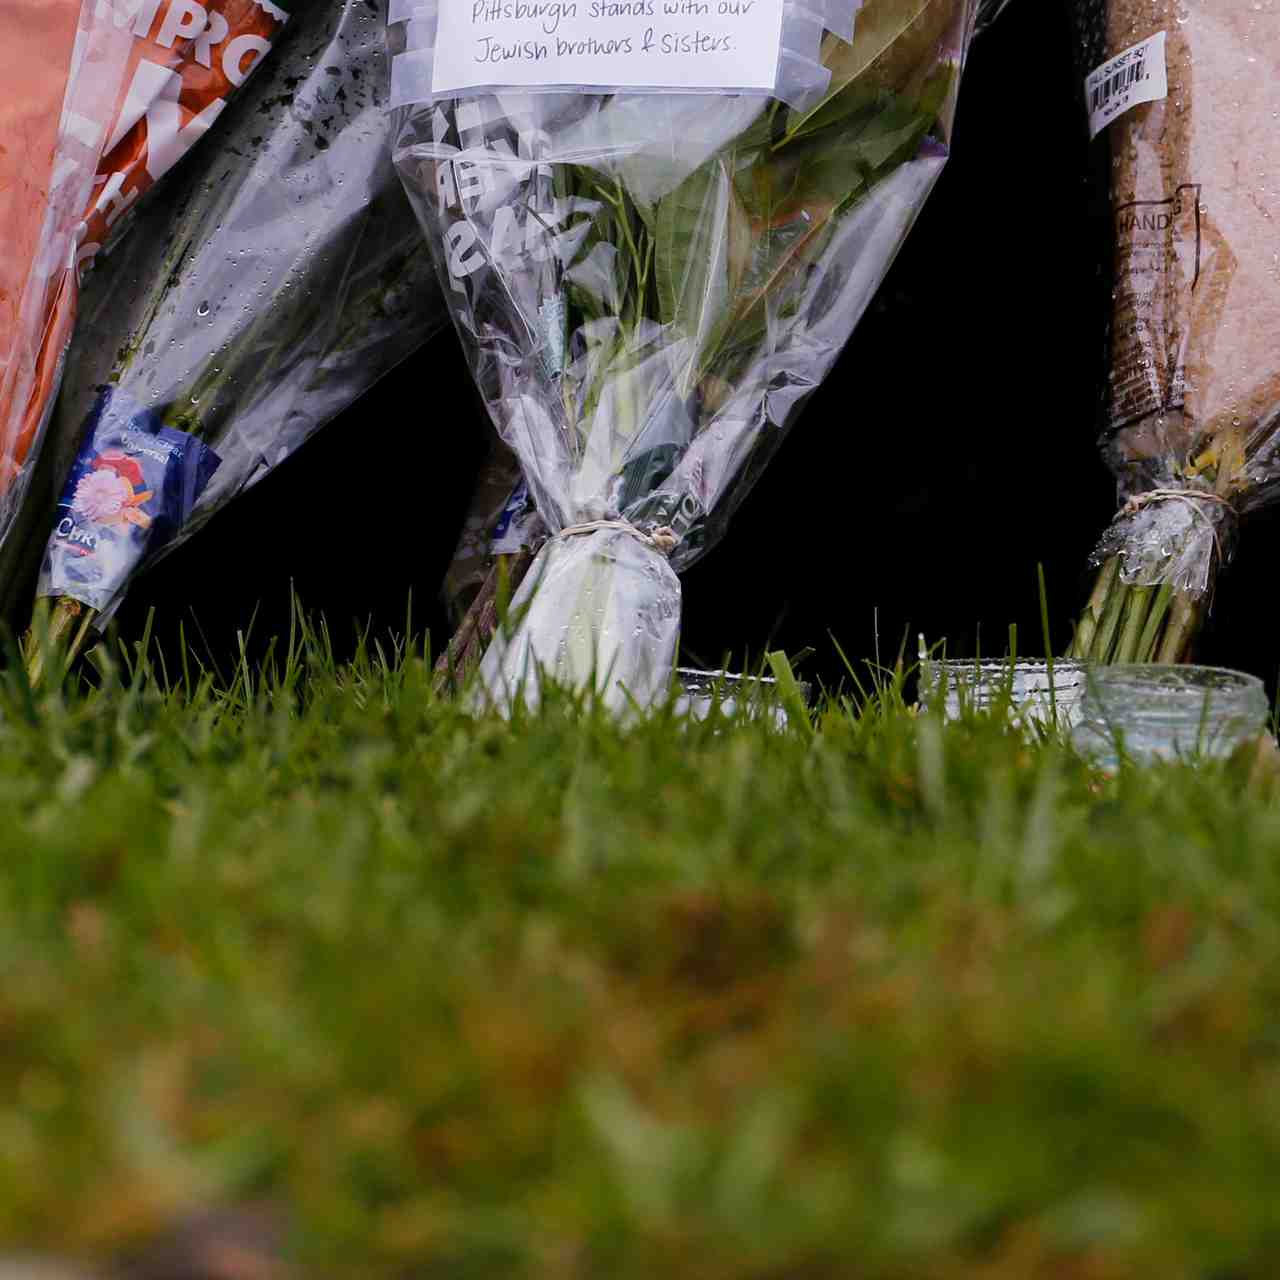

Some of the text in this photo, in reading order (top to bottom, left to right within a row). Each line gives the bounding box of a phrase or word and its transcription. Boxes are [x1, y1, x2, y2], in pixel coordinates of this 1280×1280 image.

[718, 0, 755, 15] our
[473, 35, 547, 63] Jewish
[556, 36, 632, 56] brothers
